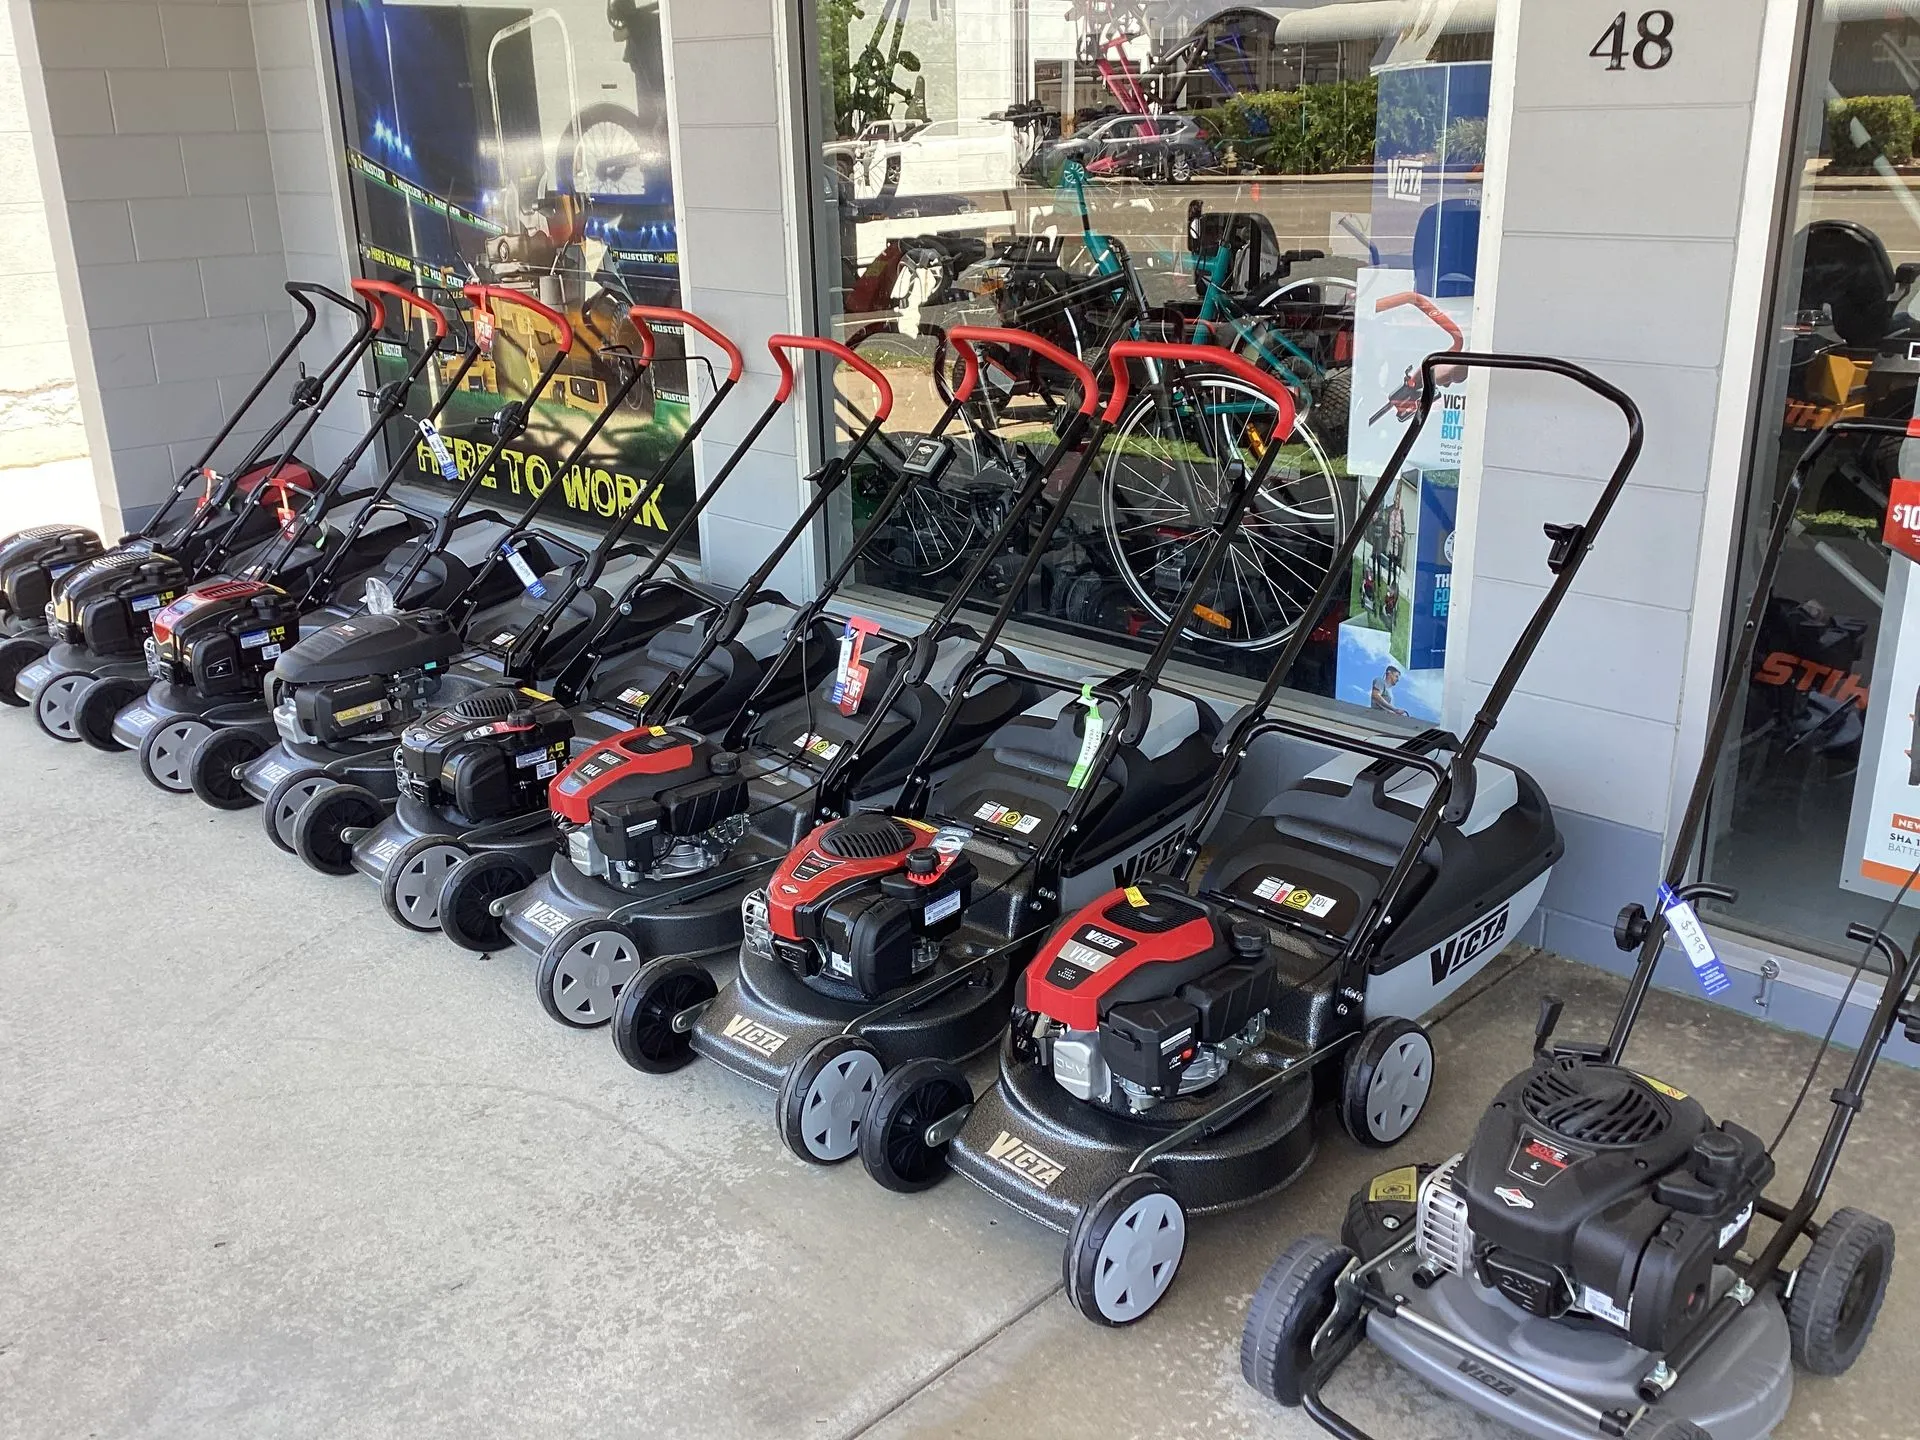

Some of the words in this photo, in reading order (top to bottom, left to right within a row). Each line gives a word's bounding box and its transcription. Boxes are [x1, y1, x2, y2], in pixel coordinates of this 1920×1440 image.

[1589, 10, 1674, 70] 48
[1387, 159, 1423, 202] VICTA
[385, 253, 395, 269] TO
[619, 251, 655, 263] HUSTLER
[1443, 410, 1461, 425] 18V
[502, 448, 552, 500] TO
[558, 460, 669, 532] WORK
[1890, 832, 1912, 845] SHA
[1069, 945, 1103, 967] V144
[1085, 929, 1125, 950] VICTA
[1430, 902, 1510, 987] VICTA
[722, 1013, 789, 1059] VICTA
[985, 1129, 1067, 1190] VICTA
[1457, 1359, 1516, 1397] VICTA
